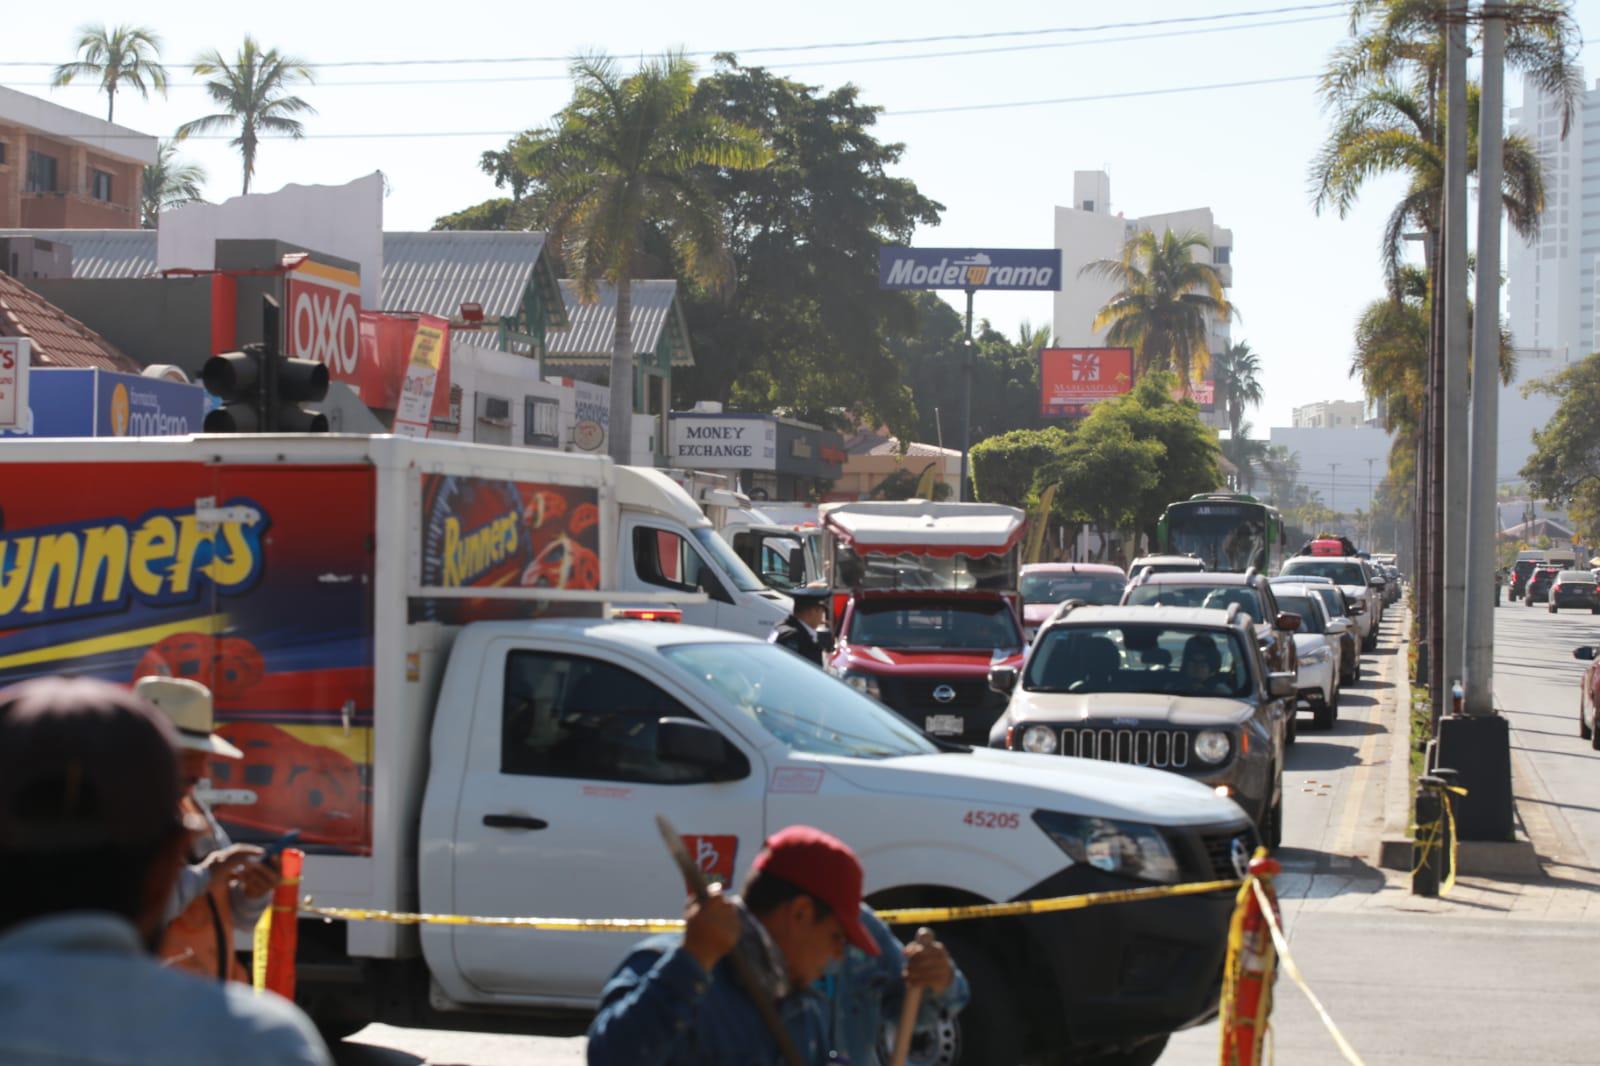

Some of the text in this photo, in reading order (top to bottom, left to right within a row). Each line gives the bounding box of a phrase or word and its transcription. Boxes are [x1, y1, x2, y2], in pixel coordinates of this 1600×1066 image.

[294, 292, 359, 375] OXXO
[686, 426, 745, 440] MONEY
[678, 444, 752, 457] EXCHANGE
[443, 511, 518, 588] Runners
[963, 810, 1020, 829] 45205
